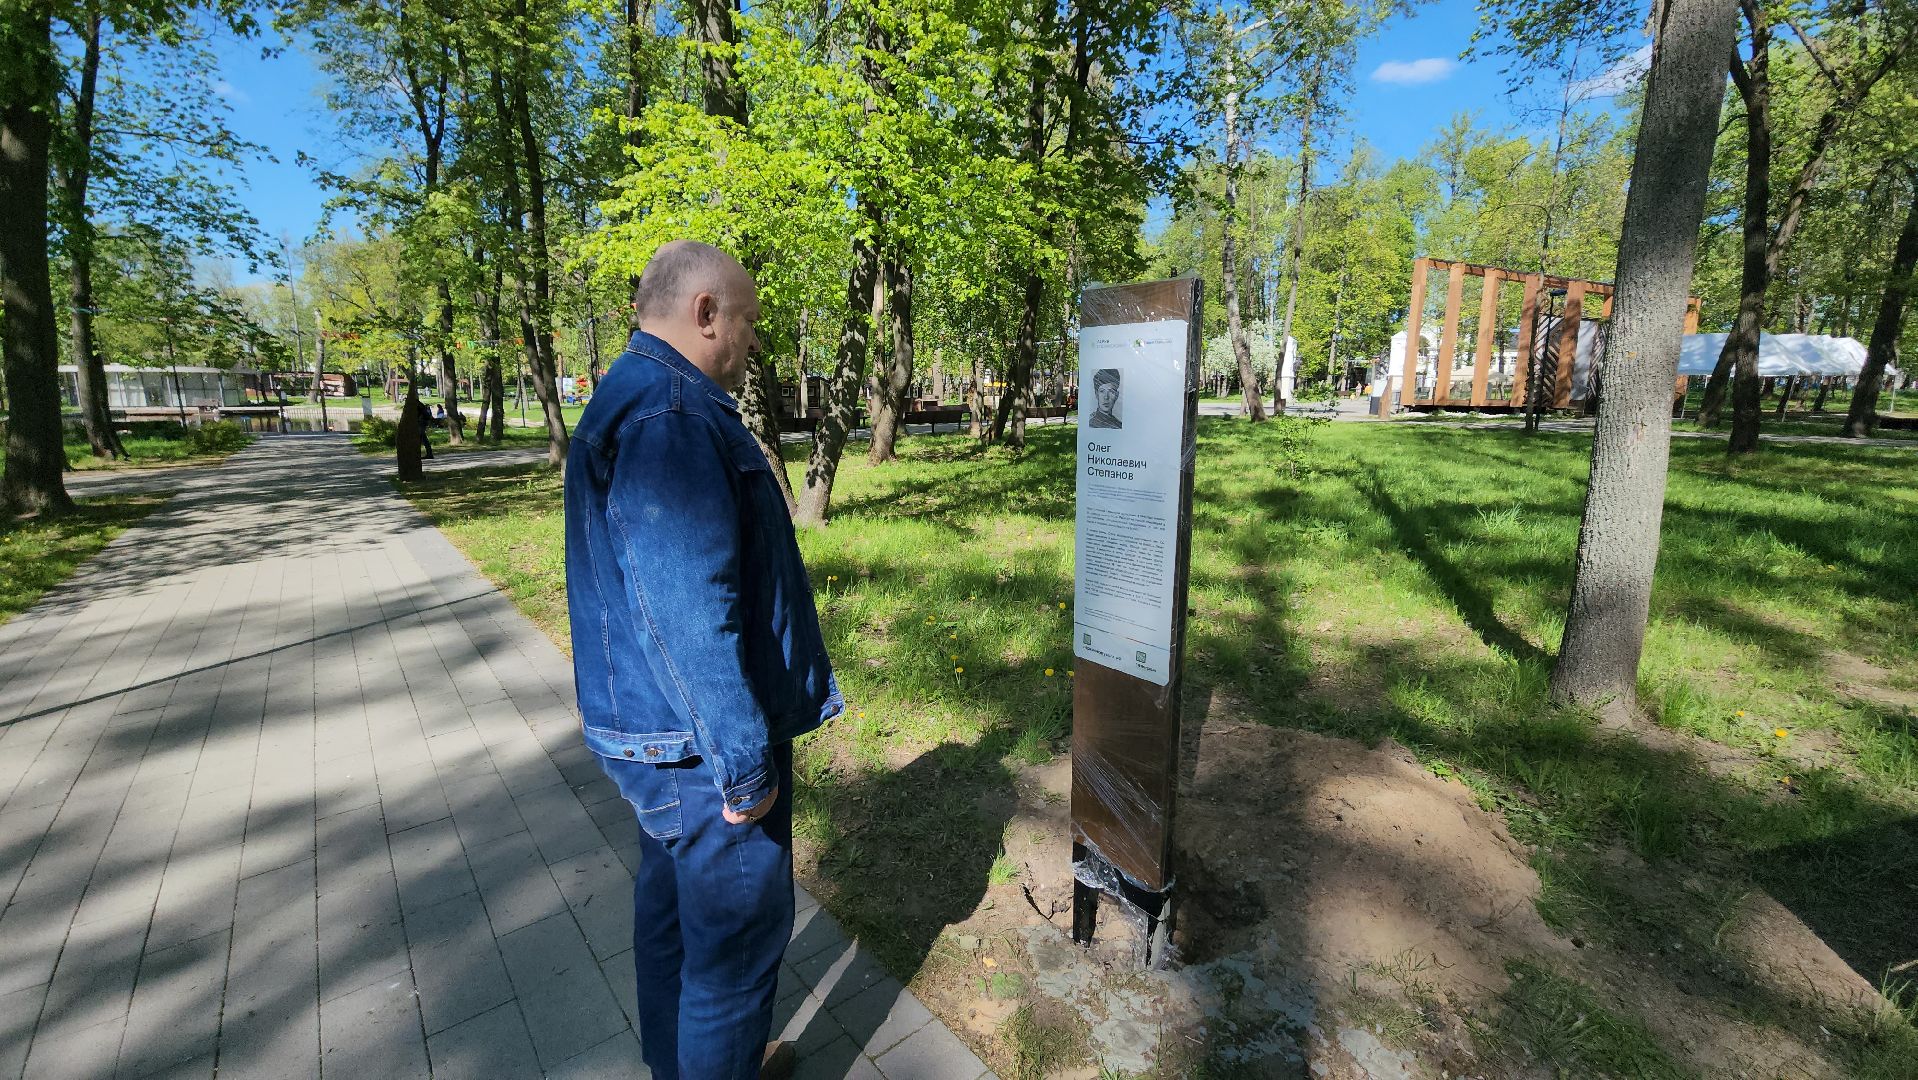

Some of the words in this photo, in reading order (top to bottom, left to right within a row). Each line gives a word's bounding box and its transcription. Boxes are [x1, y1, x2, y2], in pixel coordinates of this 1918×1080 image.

[1087, 442, 1111, 453] Олег
[1087, 454, 1147, 469] Николаевич
[1087, 466, 1134, 481] Степанов
